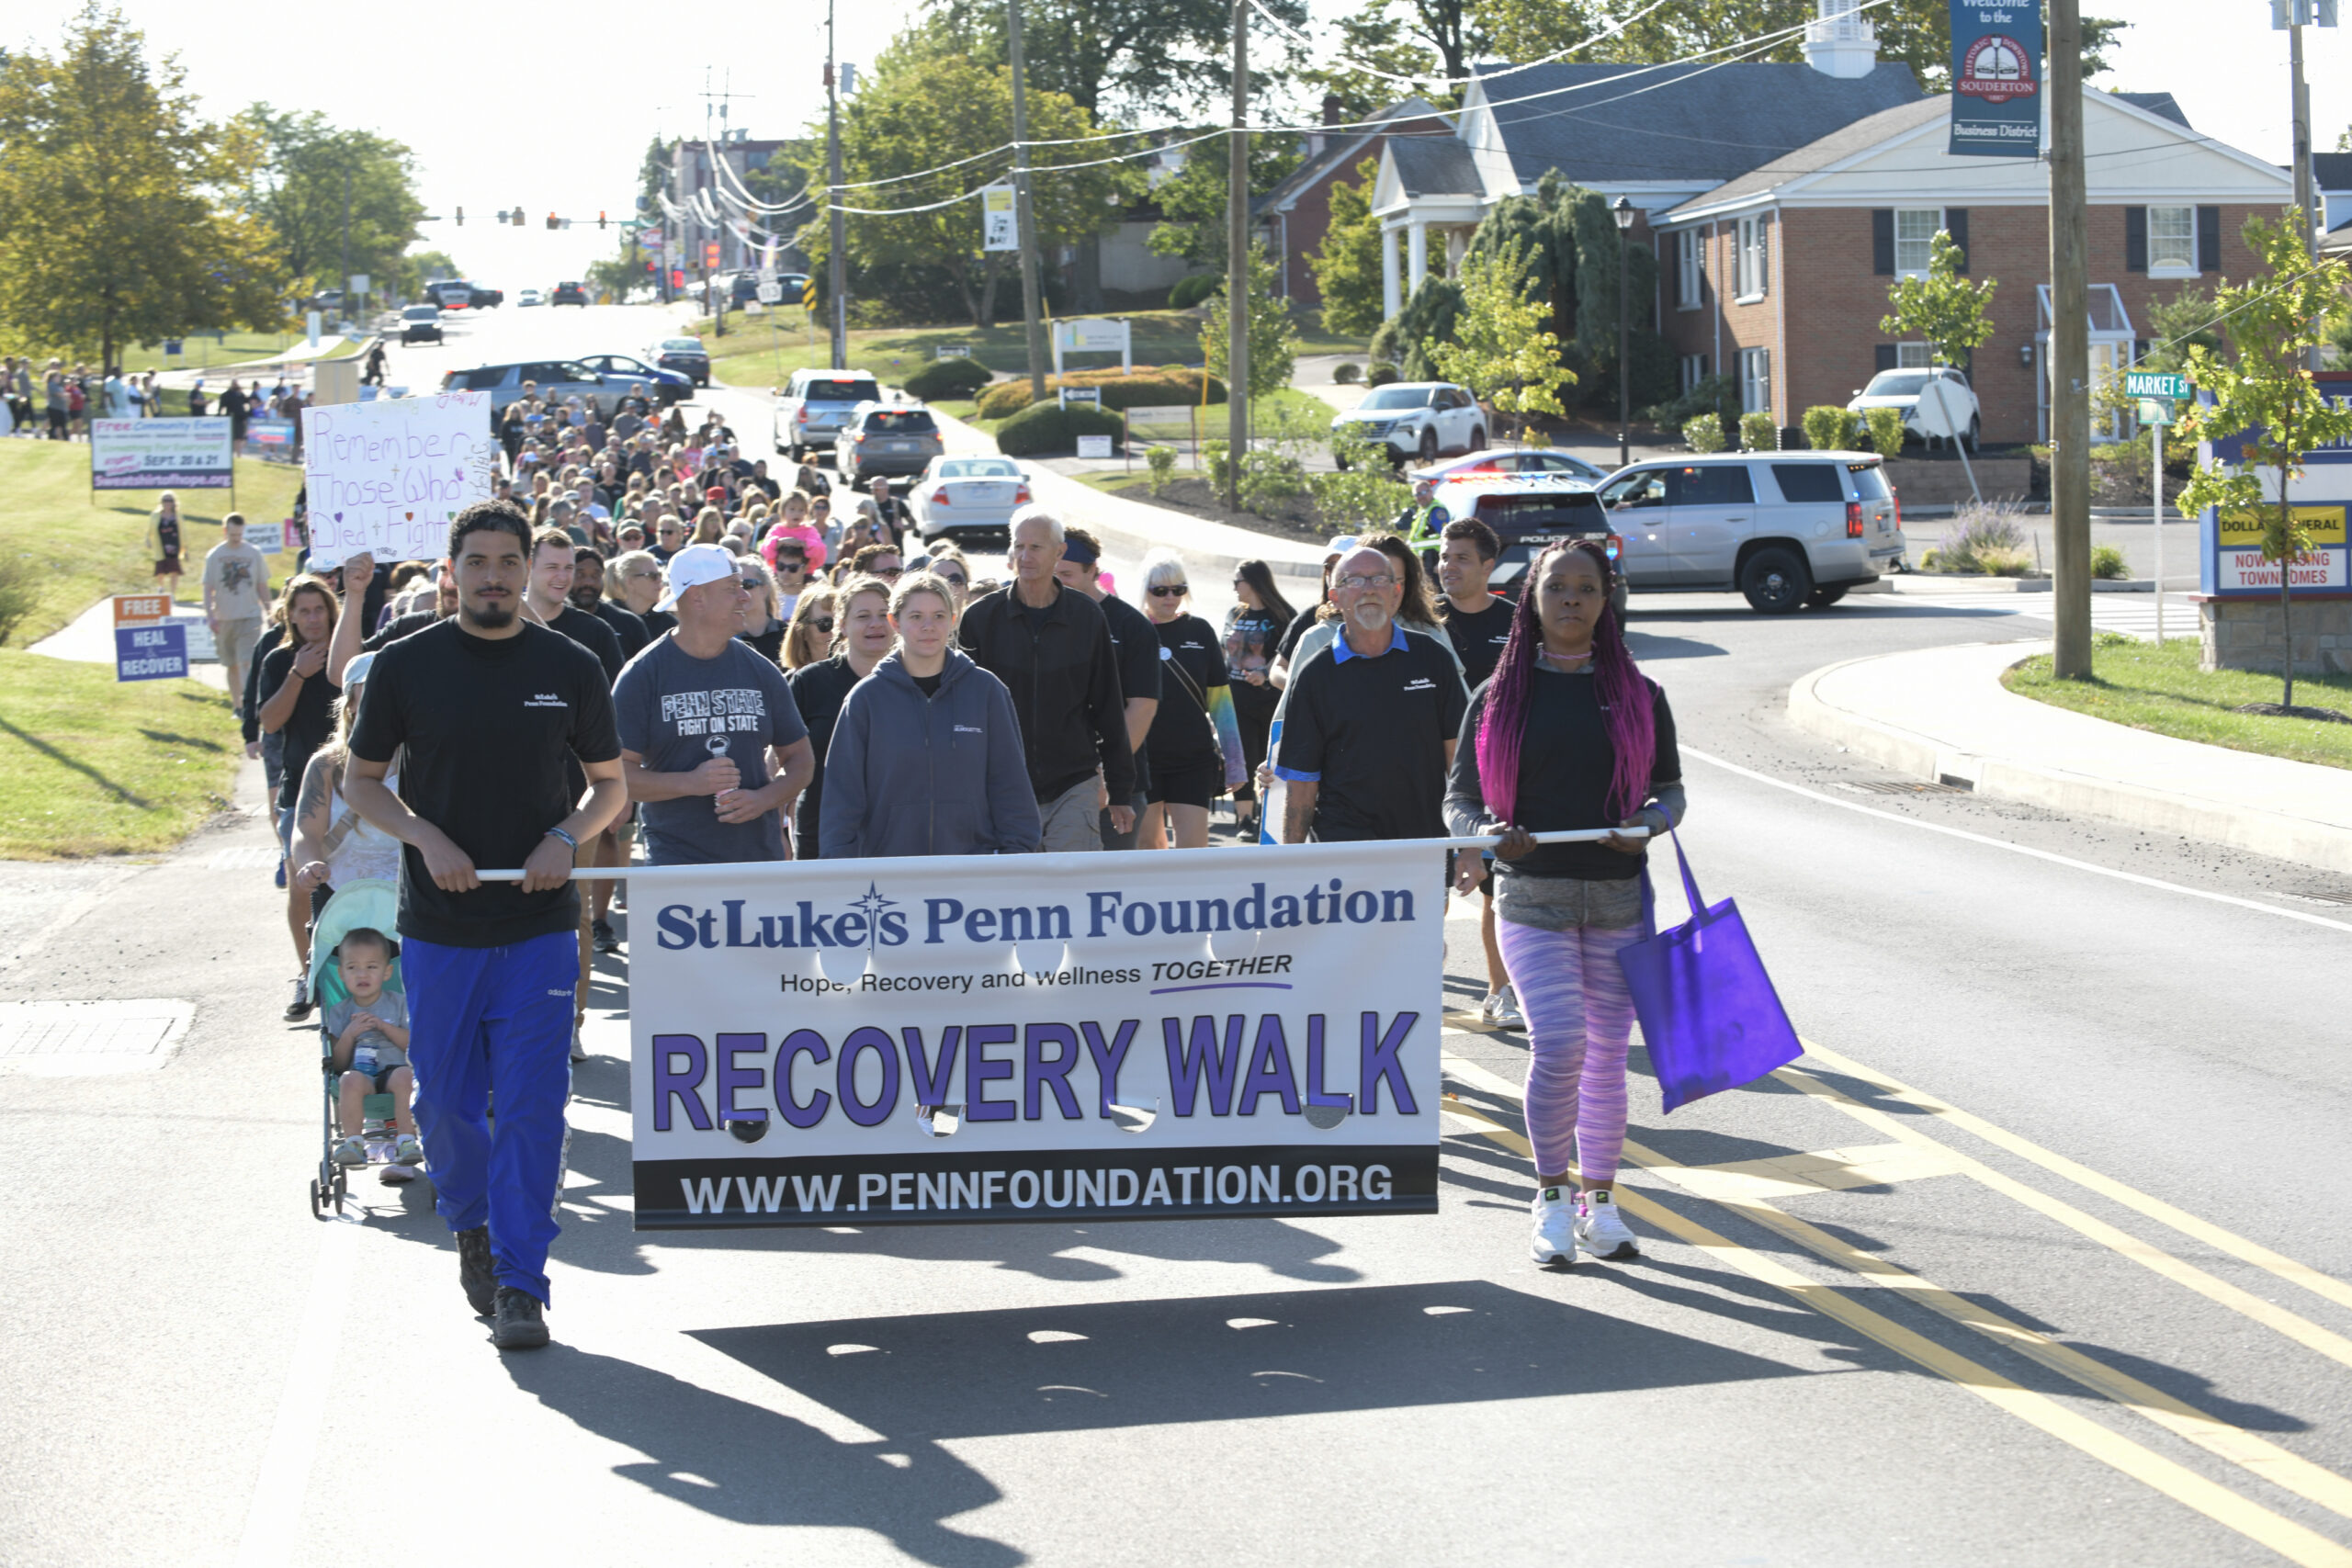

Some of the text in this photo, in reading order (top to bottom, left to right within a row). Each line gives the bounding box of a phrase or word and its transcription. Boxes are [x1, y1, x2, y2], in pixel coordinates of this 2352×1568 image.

[1980, 9, 2013, 23] to the
[1965, 39, 2030, 76] HISTORIC DOWNTOWN
[1960, 81, 2034, 92] SOUDERTON
[1953, 124, 2038, 137] Business District
[2127, 375, 2176, 395] MARKET
[96, 421, 132, 432] Free
[133, 420, 190, 432] Community
[314, 412, 471, 466] Remember
[144, 455, 175, 467] SEPT.
[95, 474, 232, 487] Sweatshirtofhope.org
[307, 465, 461, 509] Those Who
[313, 512, 368, 548] Died
[387, 504, 448, 558] Fight
[2222, 521, 2266, 532] DOLLA
[1520, 535, 1570, 543] POLICE
[2235, 552, 2331, 568] NOW LASING
[122, 599, 162, 615] FREE
[132, 629, 168, 648] HEAL
[121, 657, 184, 676] RECOVER
[661, 689, 765, 722] PENN STATE
[677, 716, 759, 737] FIGHT ON STATE
[923, 897, 1073, 944] Penn
[1086, 877, 1416, 938] Foundation
[781, 974, 852, 997] Hope,
[862, 972, 974, 994] Recovery
[981, 969, 1025, 988] and
[1151, 954, 1293, 981] TOGETHER
[652, 1011, 1420, 1132] RECOVERY WALK
[680, 1164, 1393, 1214] WWW.PENNFOUNDATION.ORG
